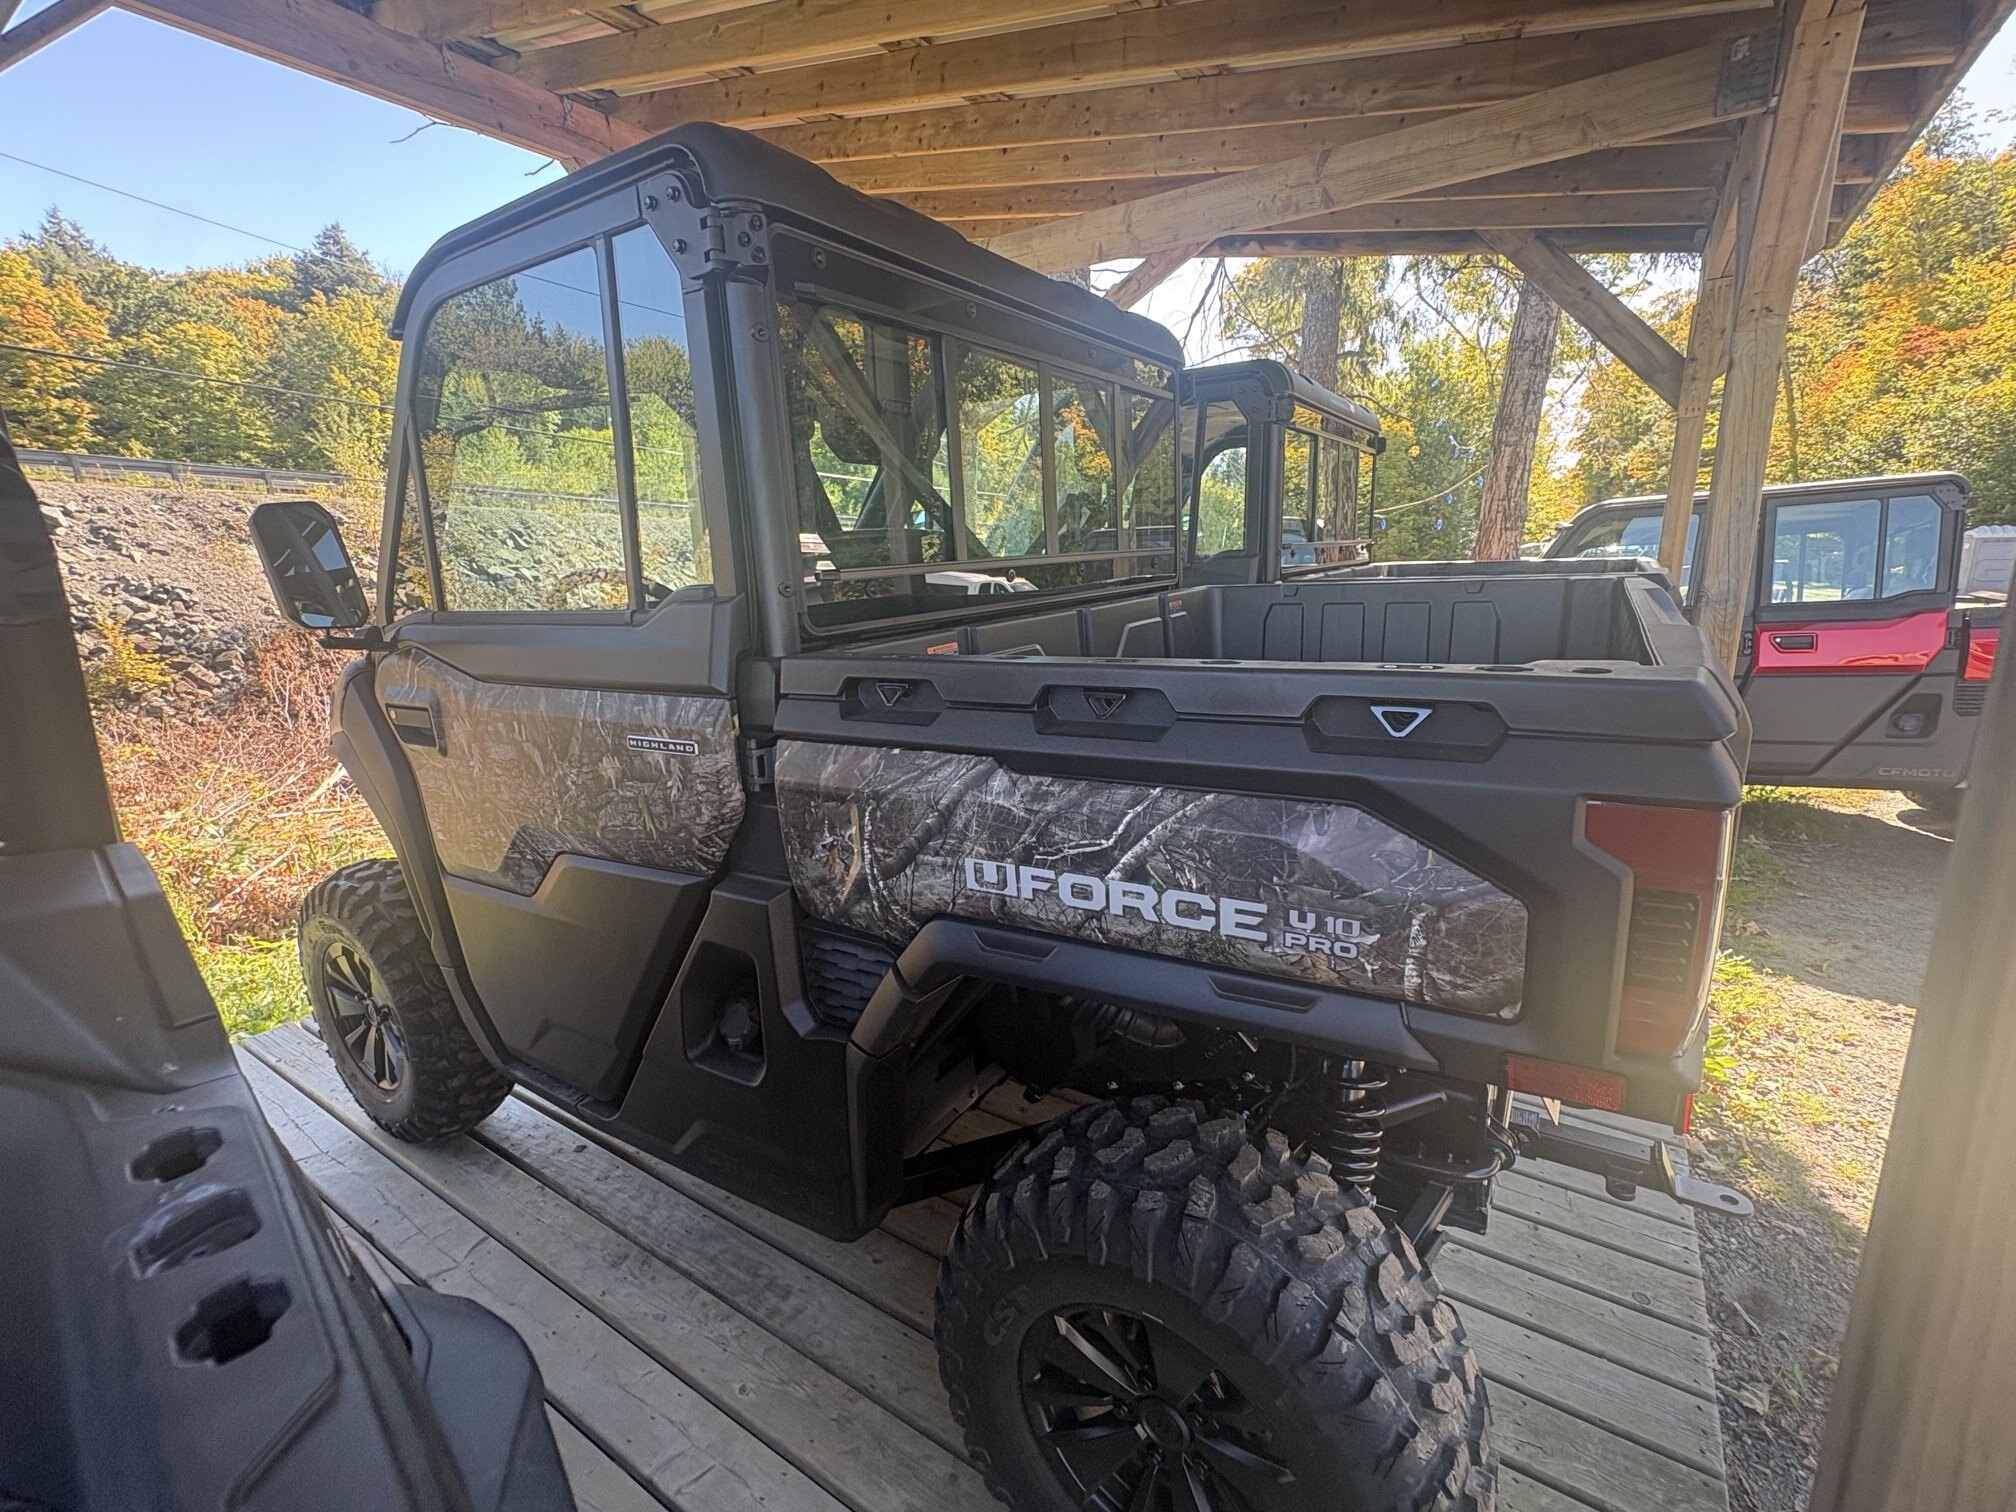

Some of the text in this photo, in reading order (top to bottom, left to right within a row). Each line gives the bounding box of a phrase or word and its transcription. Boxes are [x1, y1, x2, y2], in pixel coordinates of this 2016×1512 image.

[629, 739, 694, 752] HIGHLAND
[1879, 767, 1957, 778] CFMOTO
[1284, 932, 1358, 959] PRO
